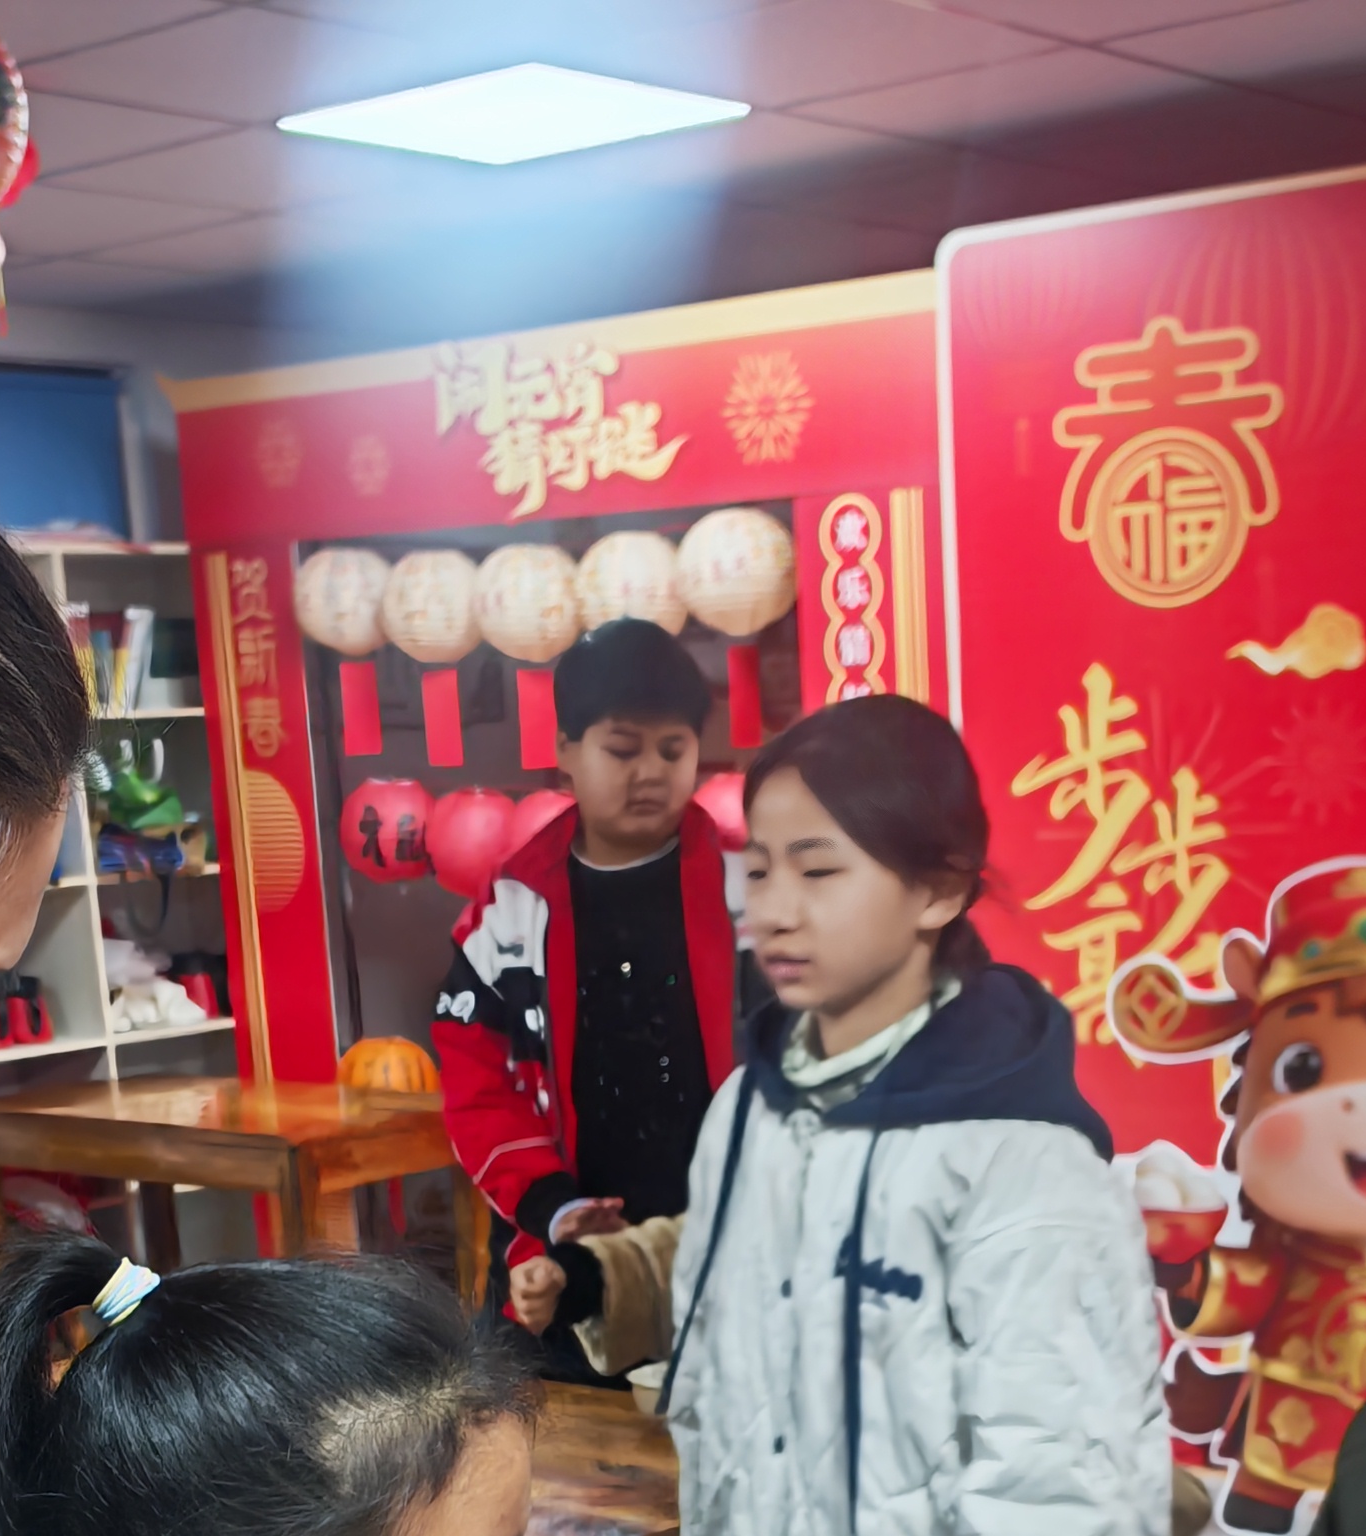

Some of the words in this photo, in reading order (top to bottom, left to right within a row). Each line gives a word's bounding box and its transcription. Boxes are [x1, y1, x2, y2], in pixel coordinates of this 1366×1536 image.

[434, 341, 620, 437] 闹元宵
[480, 400, 691, 522] 猜灯谜
[231, 557, 288, 758] 贺新春
